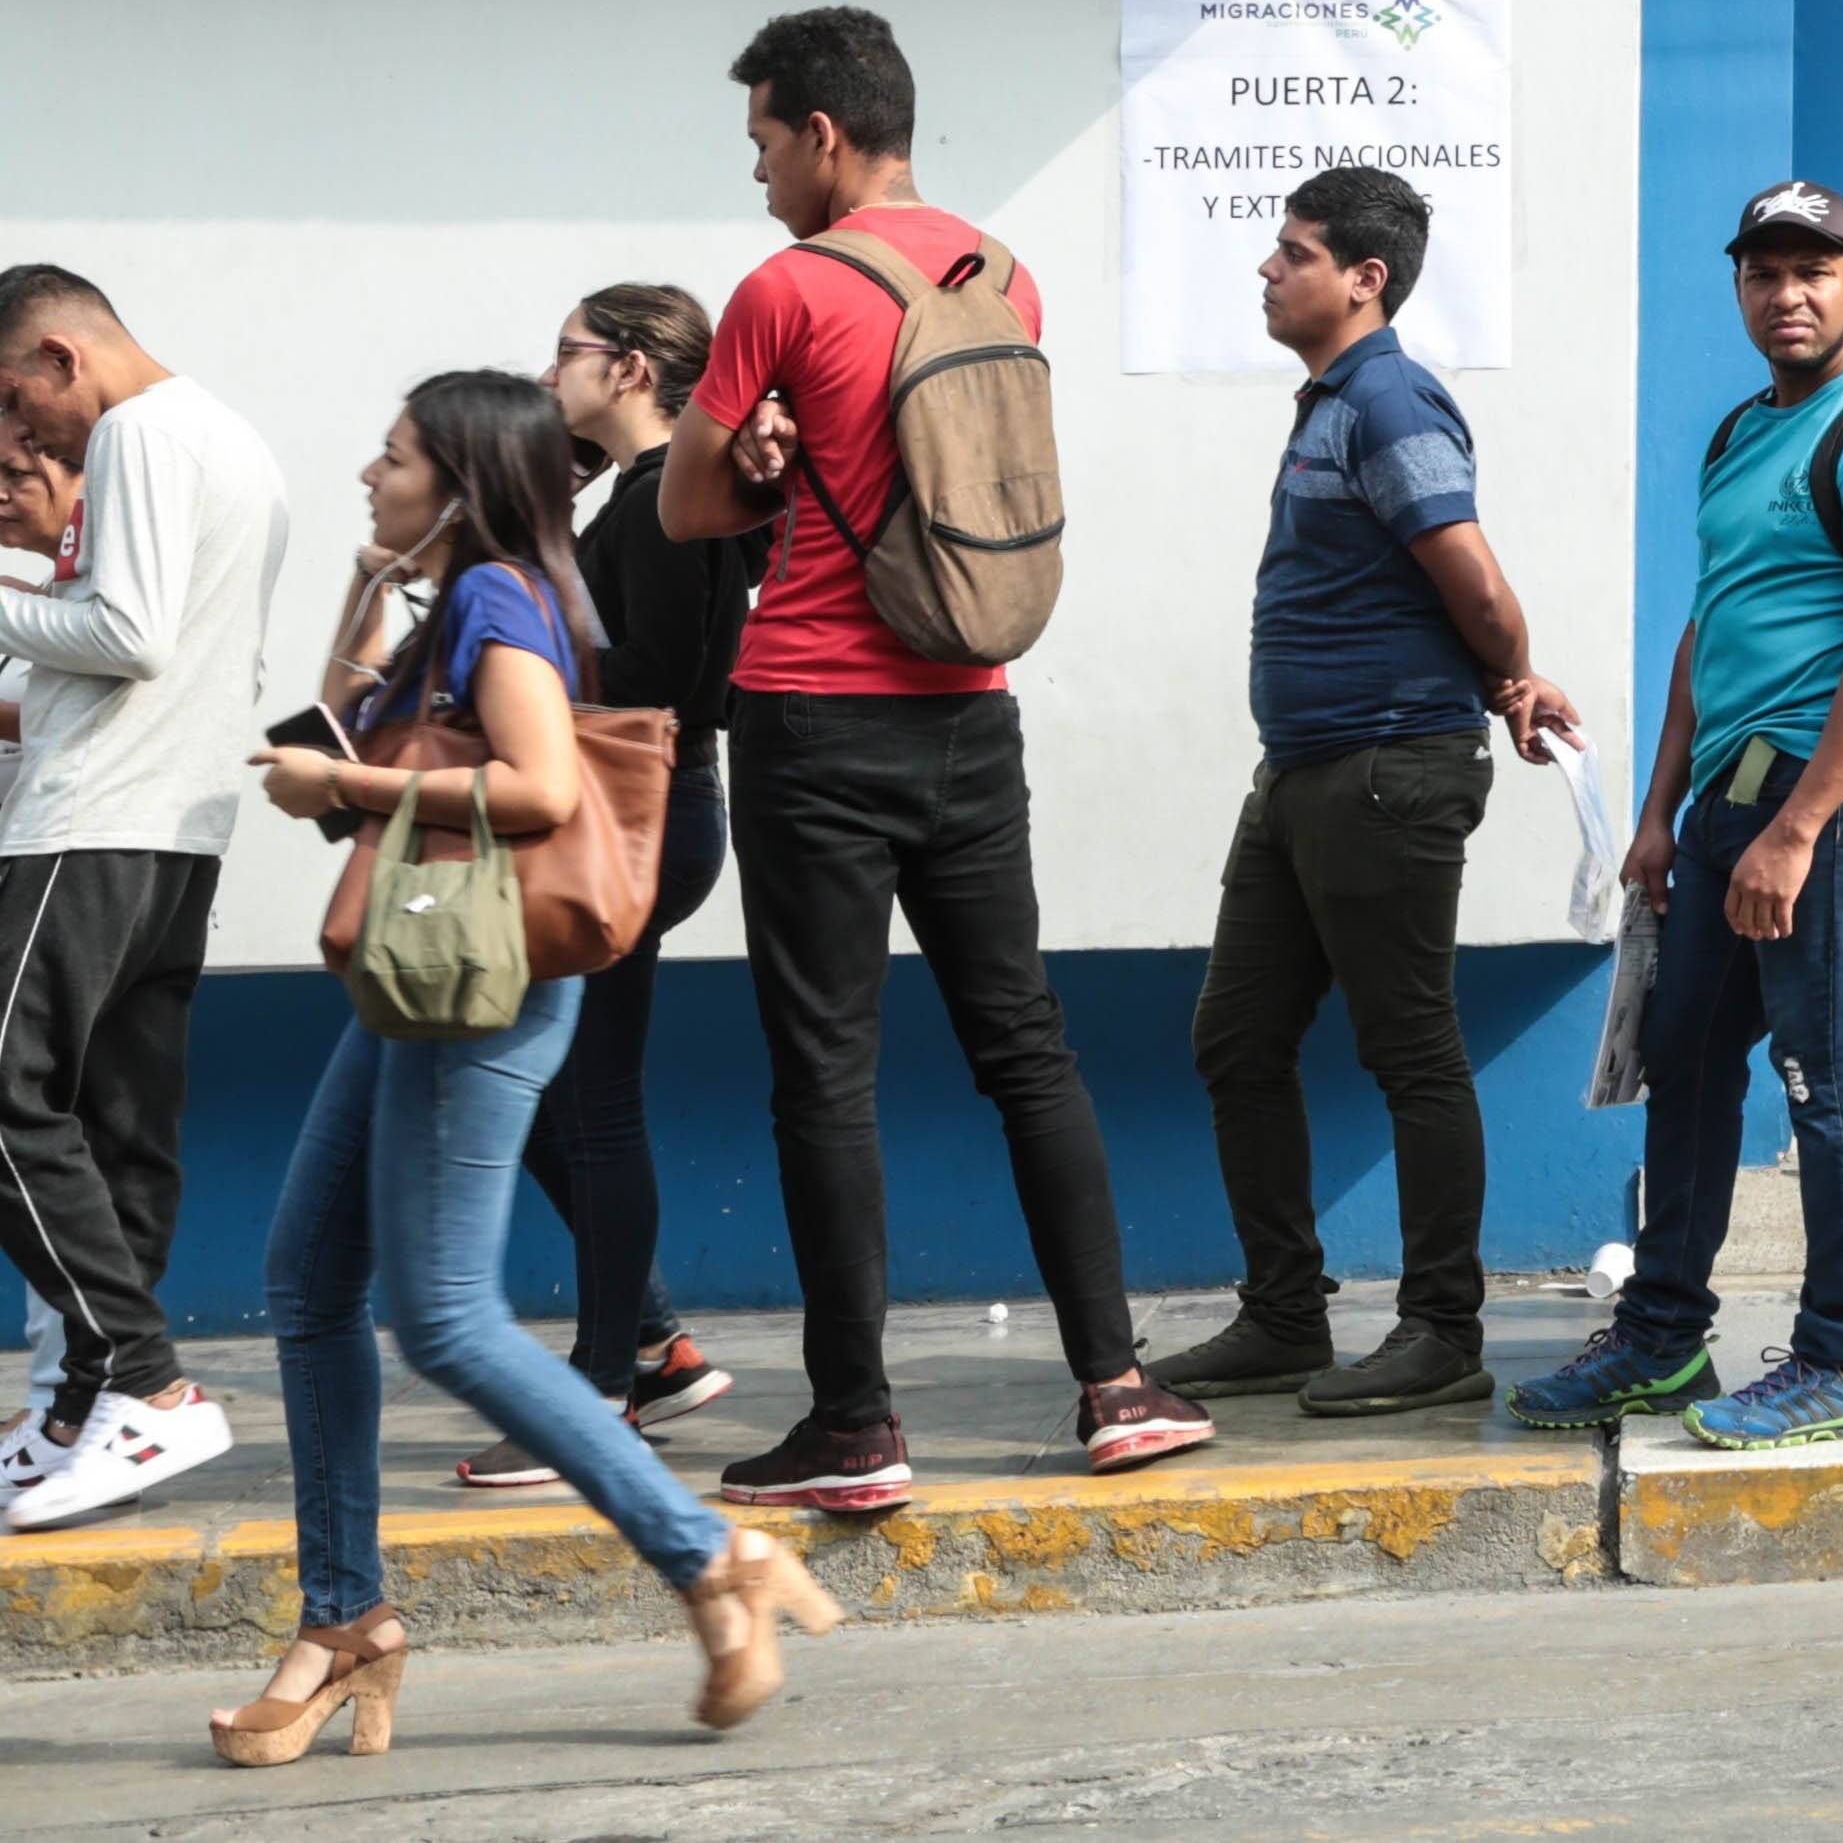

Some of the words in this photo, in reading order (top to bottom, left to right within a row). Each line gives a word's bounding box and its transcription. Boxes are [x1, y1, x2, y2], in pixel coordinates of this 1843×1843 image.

[1200, 2, 1369, 20] MIGRACIONES
[1231, 76, 1375, 106] PUERTA
[1387, 76, 1417, 105] 2:
[1143, 145, 1304, 169] -TRAMITES
[1315, 144, 1501, 169] NACIONALES
[1203, 196, 1219, 219] Y
